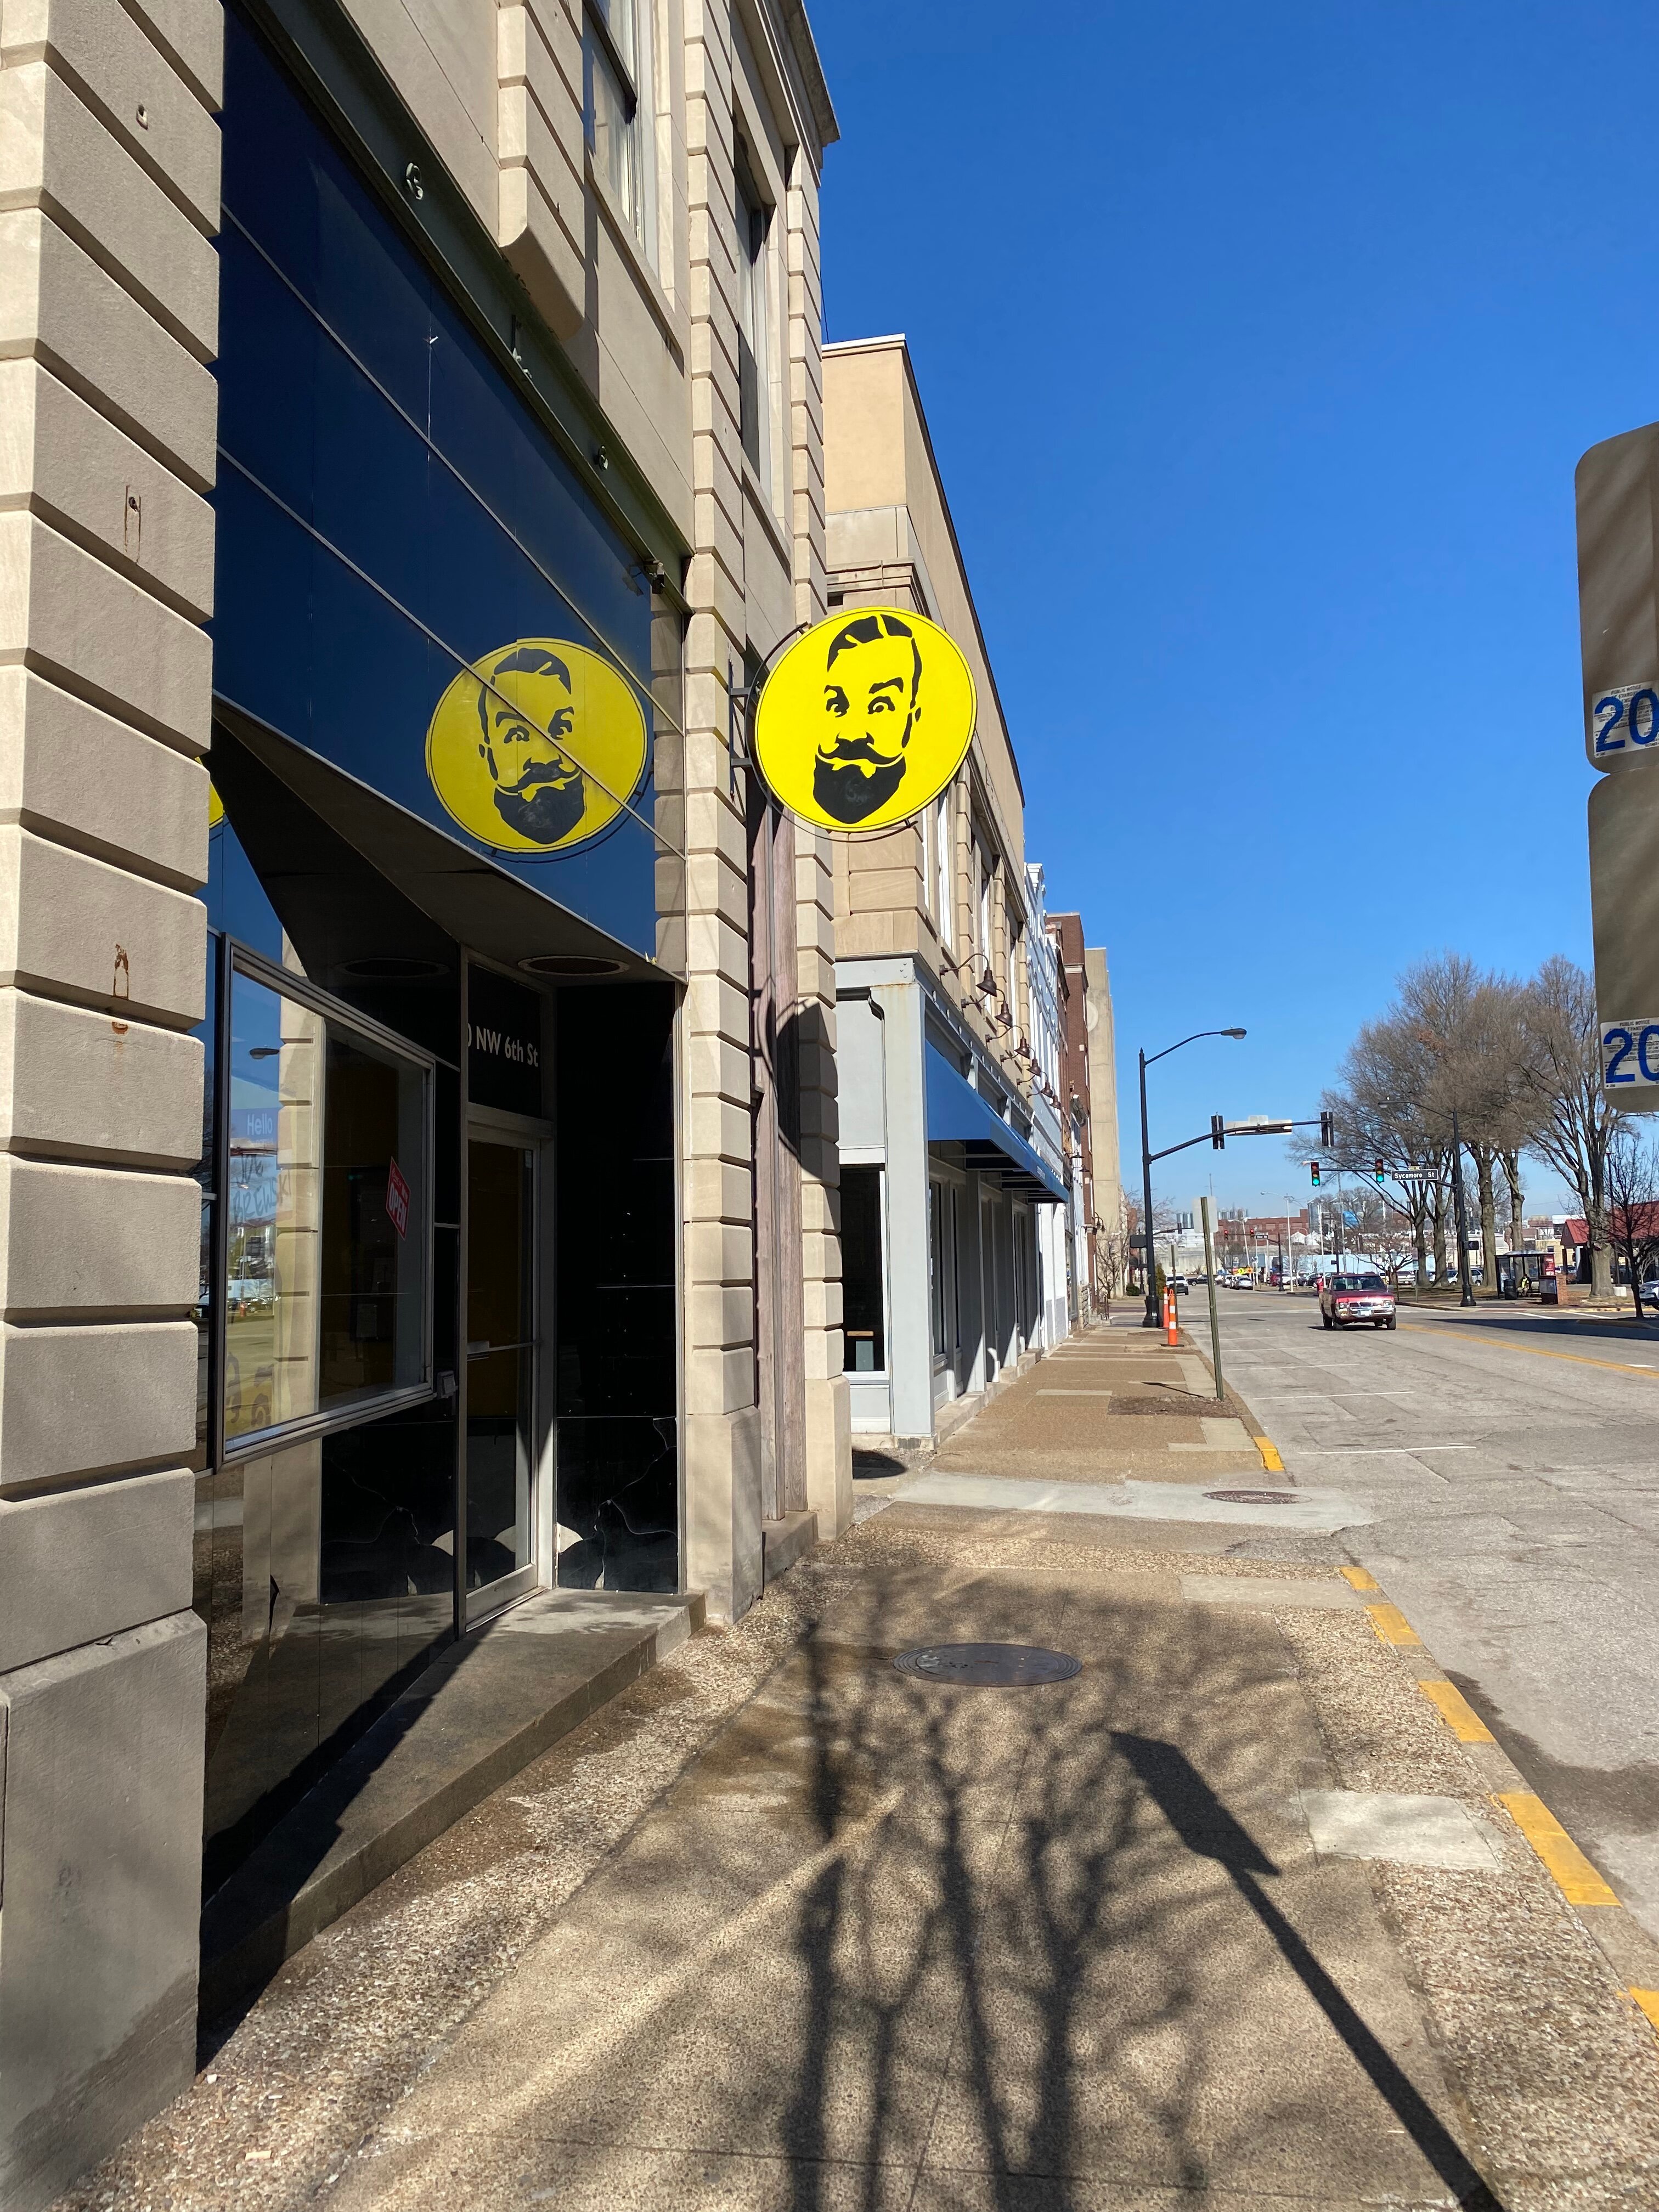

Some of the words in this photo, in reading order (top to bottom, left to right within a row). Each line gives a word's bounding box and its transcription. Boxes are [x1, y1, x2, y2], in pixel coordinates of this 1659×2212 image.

[476, 1026, 501, 1055] NW
[504, 1036, 523, 1063] 6th
[527, 1043, 539, 1067] St
[247, 1113, 273, 1136] Hello
[388, 1182, 407, 1233] OPEN
